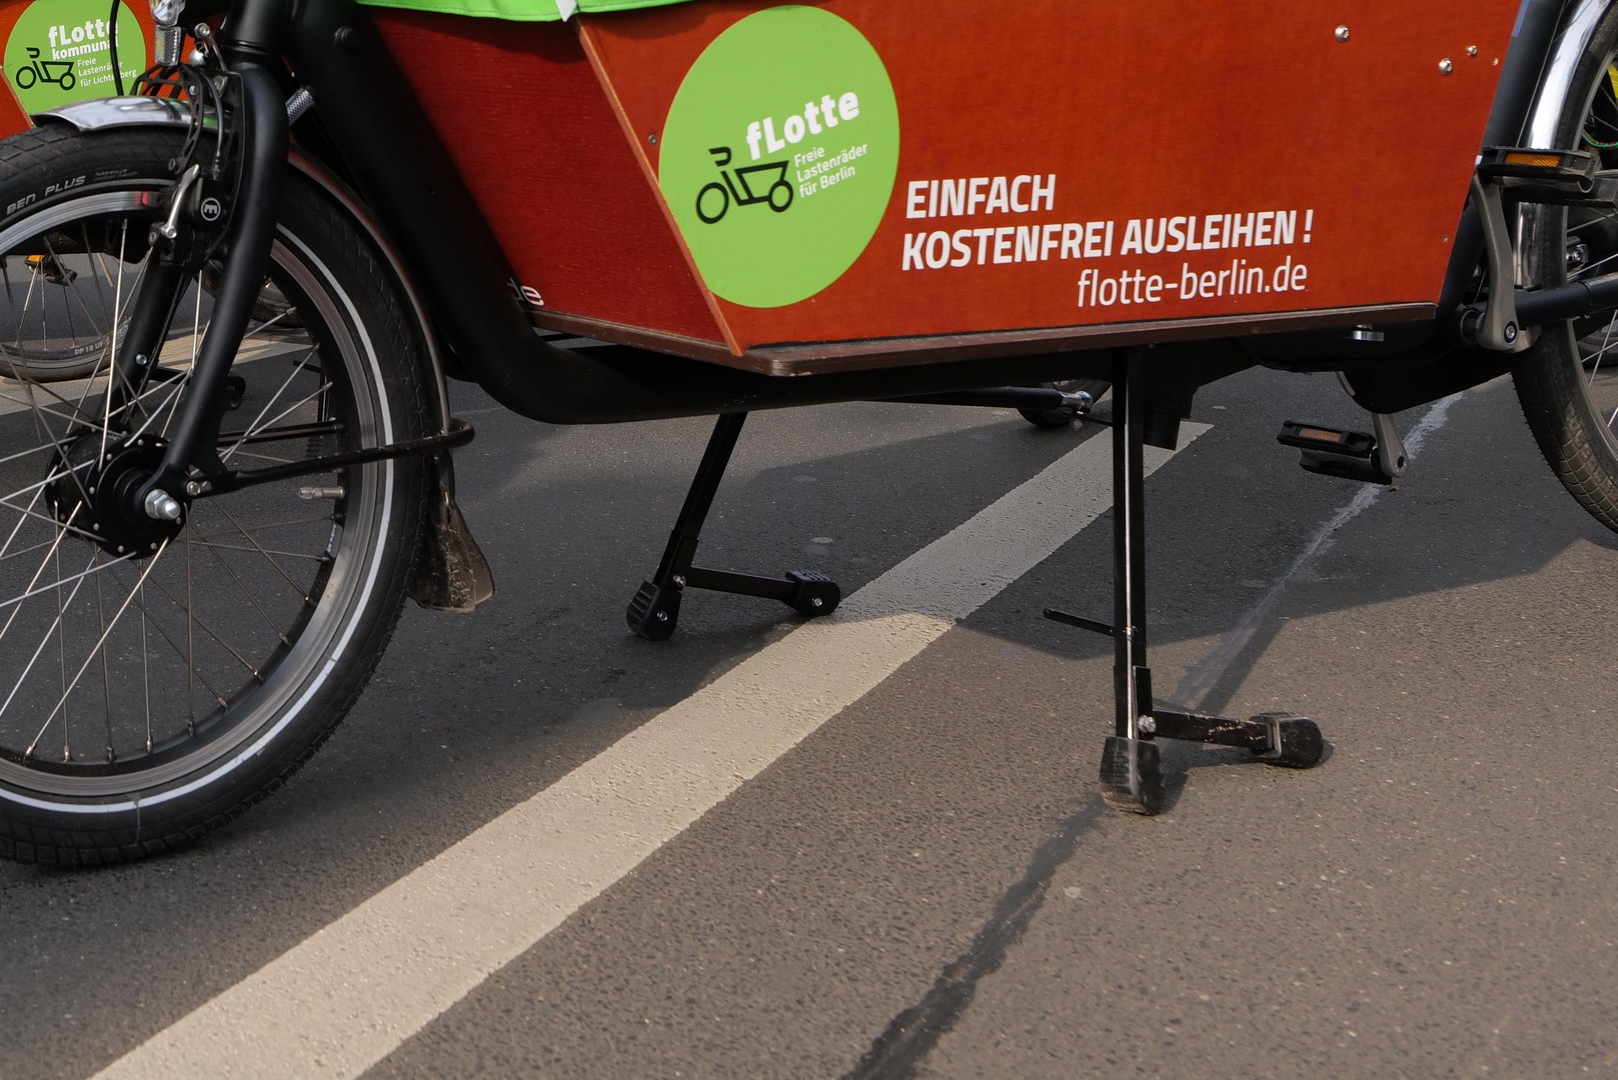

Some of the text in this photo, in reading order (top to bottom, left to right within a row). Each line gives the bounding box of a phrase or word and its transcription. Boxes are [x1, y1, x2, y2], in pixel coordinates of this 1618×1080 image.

[77, 57, 96, 67] Freie
[80, 78, 92, 87] für
[745, 91, 860, 161] fLotte
[793, 146, 826, 168] Freie
[796, 143, 869, 183] Lastenräder
[6, 192, 37, 214] BEN
[45, 175, 87, 197] PLUS
[798, 166, 856, 198] für Berlin
[905, 173, 1056, 219] EINFACH
[901, 220, 1114, 271] KOSTENFREI
[1120, 210, 1297, 256] AUSLEIHEN
[1077, 255, 1308, 307] flotte-berlin.de
